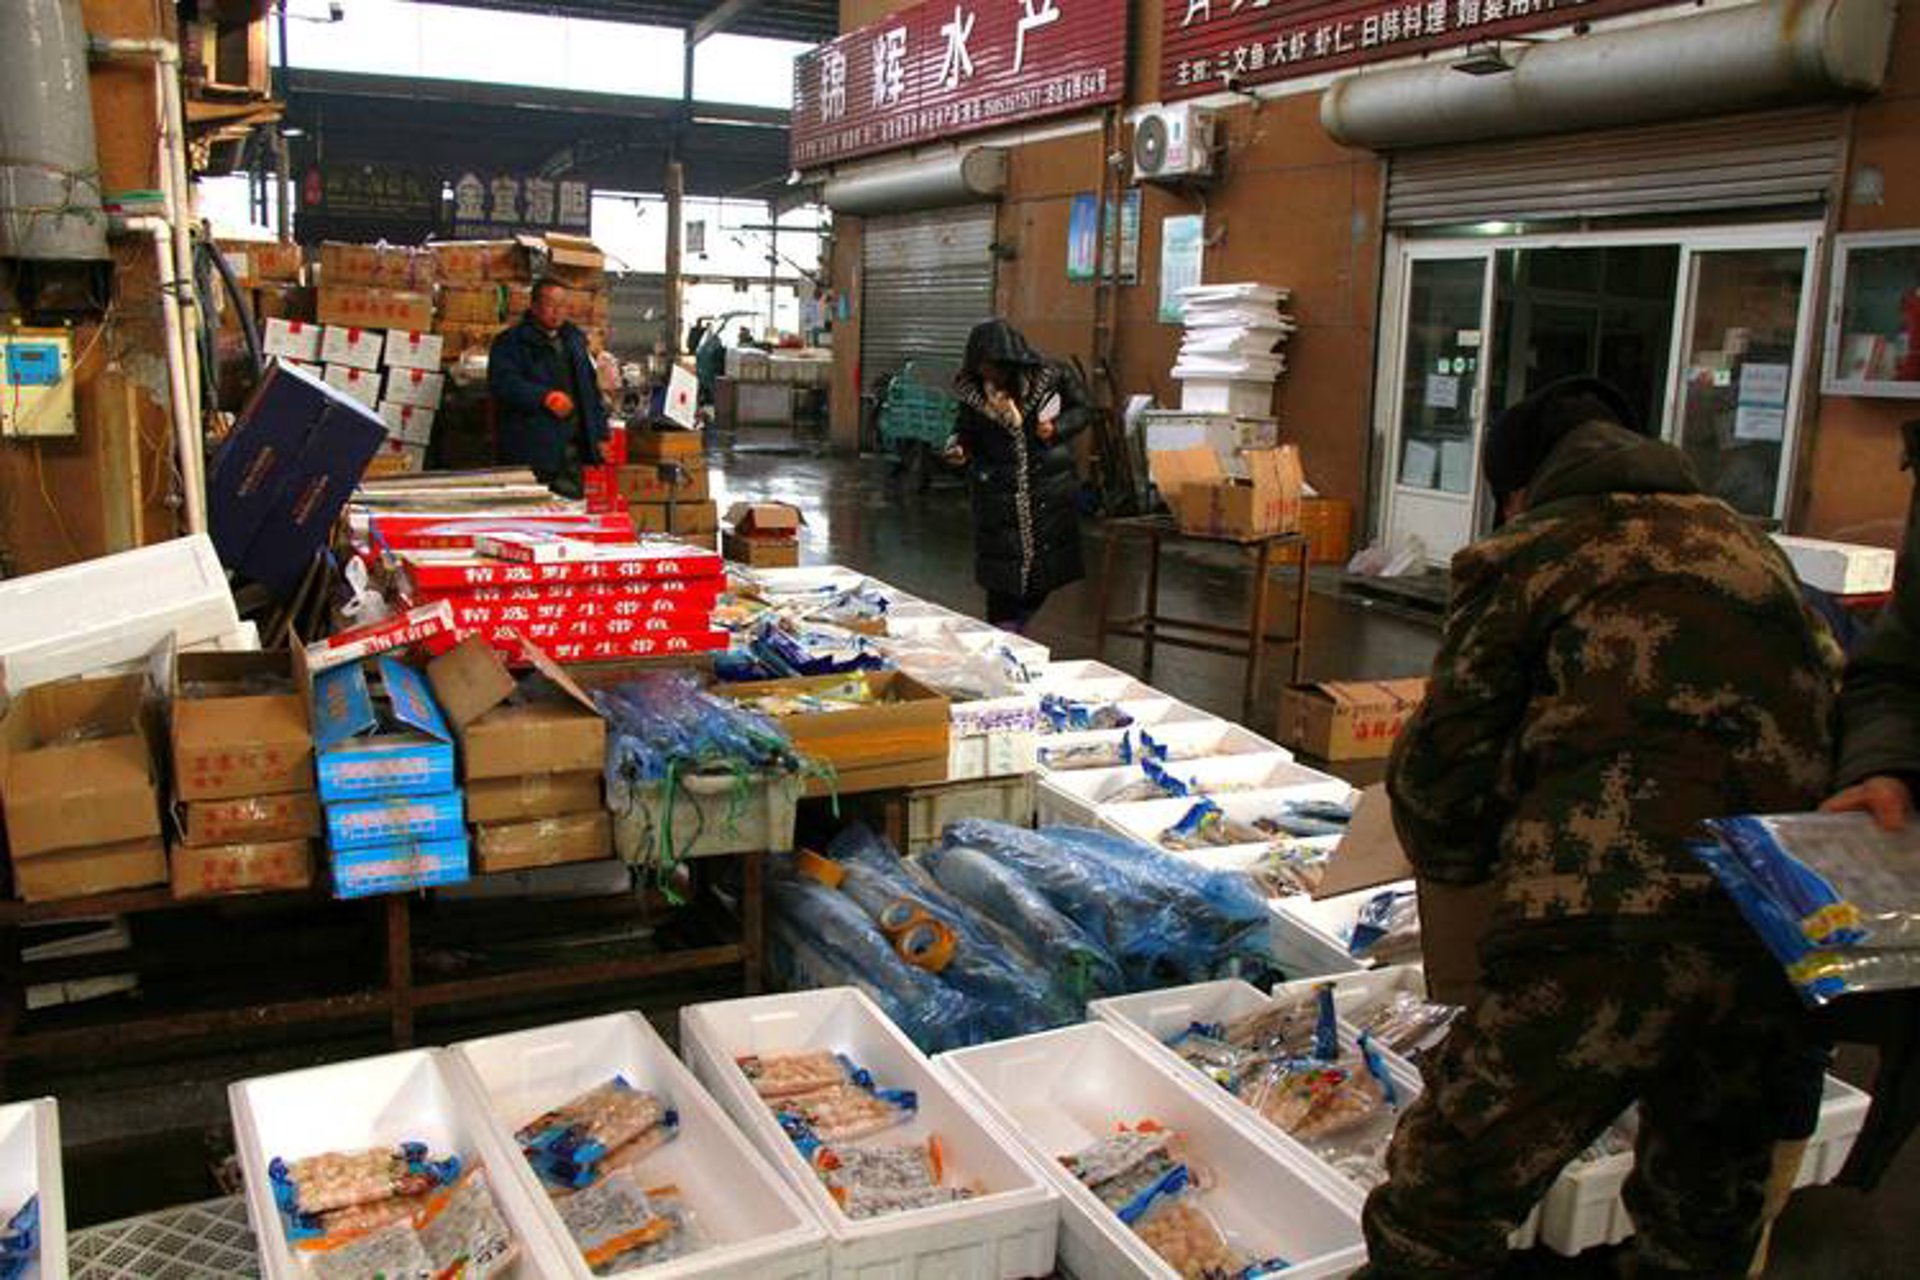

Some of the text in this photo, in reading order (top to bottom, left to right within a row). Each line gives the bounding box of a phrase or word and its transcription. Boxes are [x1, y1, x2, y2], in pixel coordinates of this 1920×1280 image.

[1216, 43, 1265, 75] 三文鱼
[1271, 33, 1306, 64] 大虾
[1313, 23, 1354, 55] 虾仁
[1361, 1, 1447, 47] 日韩料理
[466, 561, 681, 583] 精选野生带鱼
[475, 581, 685, 601] 精选野生带鱼
[461, 600, 675, 625] 精选野生带鱼
